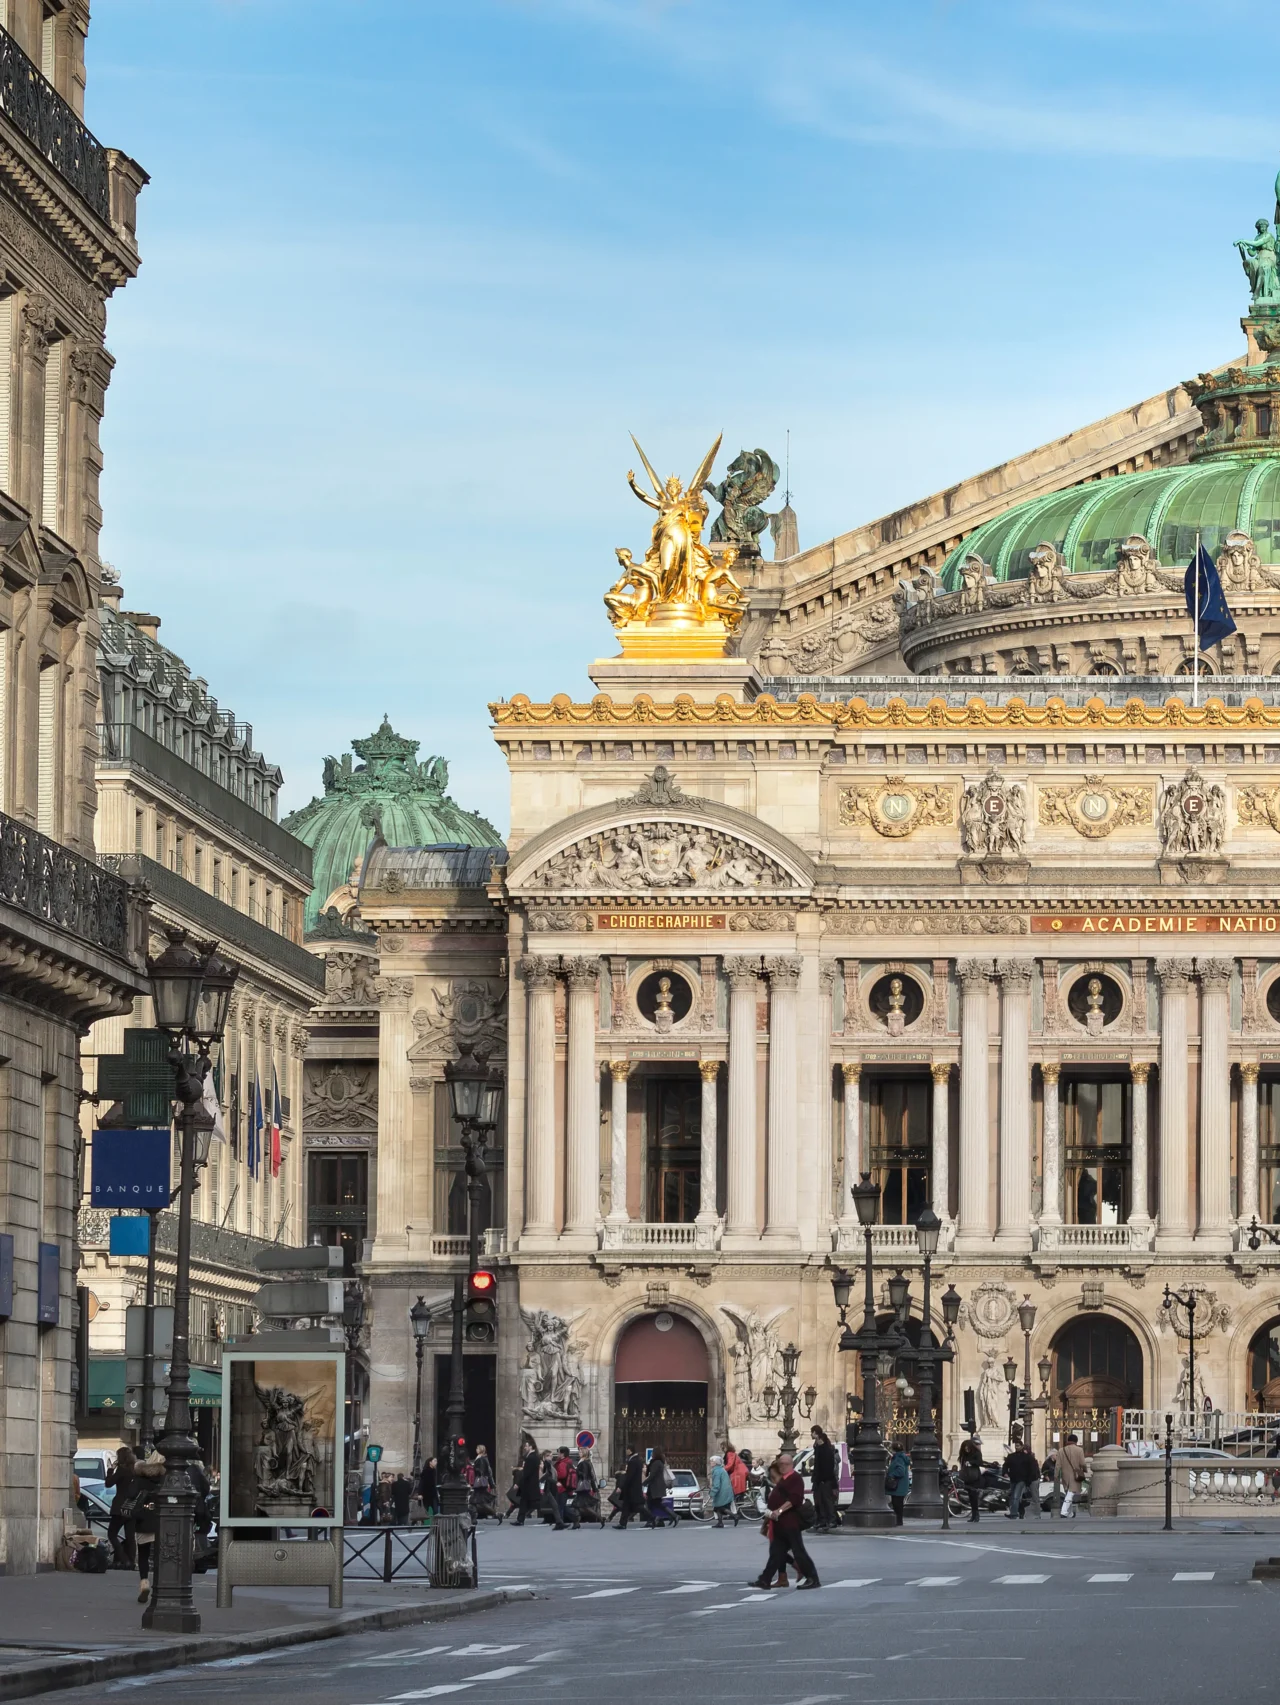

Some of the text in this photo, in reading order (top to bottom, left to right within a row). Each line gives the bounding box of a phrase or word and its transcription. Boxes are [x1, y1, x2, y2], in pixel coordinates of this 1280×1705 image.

[889, 800, 902, 813] N
[990, 800, 999, 812] E
[1089, 800, 1100, 812] N
[1189, 800, 1198, 812] E
[610, 916, 714, 928] CHOREGRAPHIE
[1082, 917, 1198, 932] ACADEMIE
[95, 1185, 164, 1194] BANQUE
